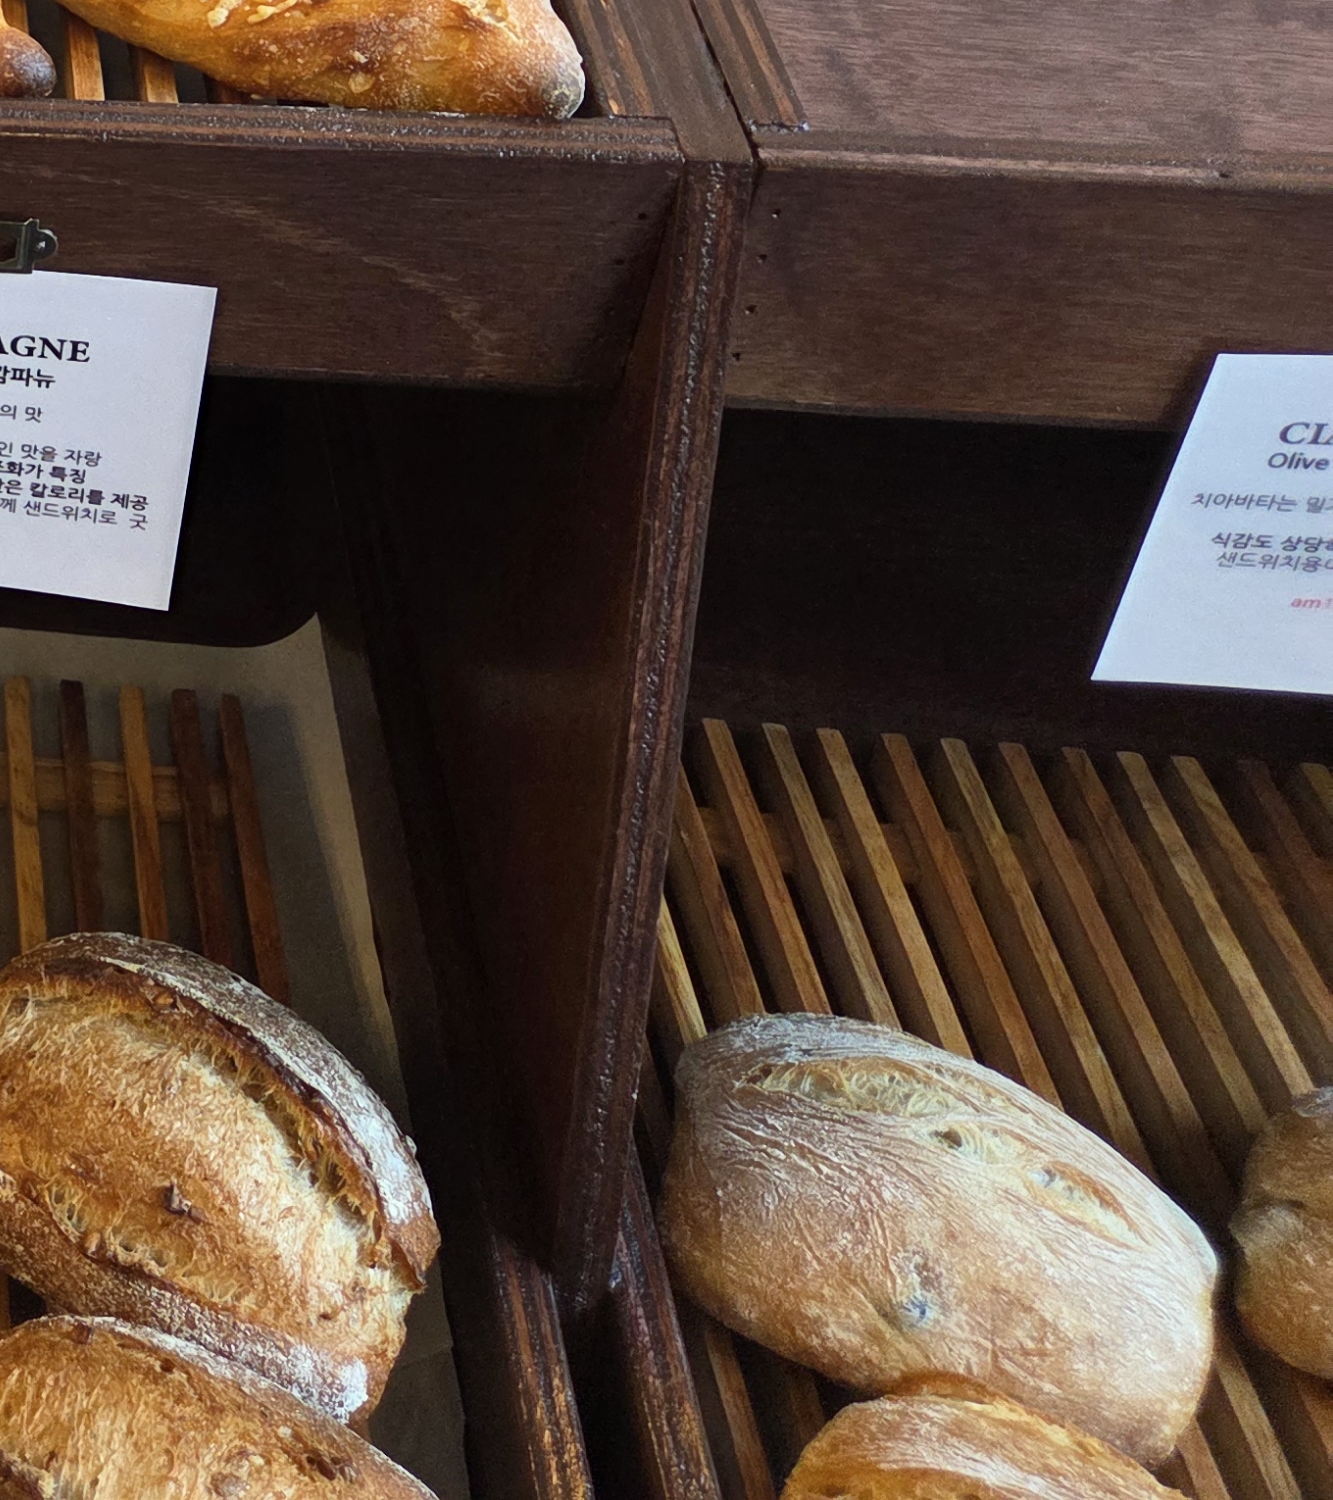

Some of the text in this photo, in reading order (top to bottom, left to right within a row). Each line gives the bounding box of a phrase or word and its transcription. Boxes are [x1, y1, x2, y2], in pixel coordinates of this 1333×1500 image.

[25, 406, 42, 423] 맛
[21, 444, 58, 462] 맛을
[63, 449, 102, 467] 자랑
[1267, 452, 1329, 471] Olive
[49, 466, 86, 484] 특징
[29, 482, 105, 505] 칼로리를
[110, 493, 148, 511] 제공
[1191, 493, 1298, 512] 치아바타는
[23, 500, 117, 524] 샌드위치로
[129, 513, 148, 530] 굿
[1211, 532, 1273, 550] 식감도
